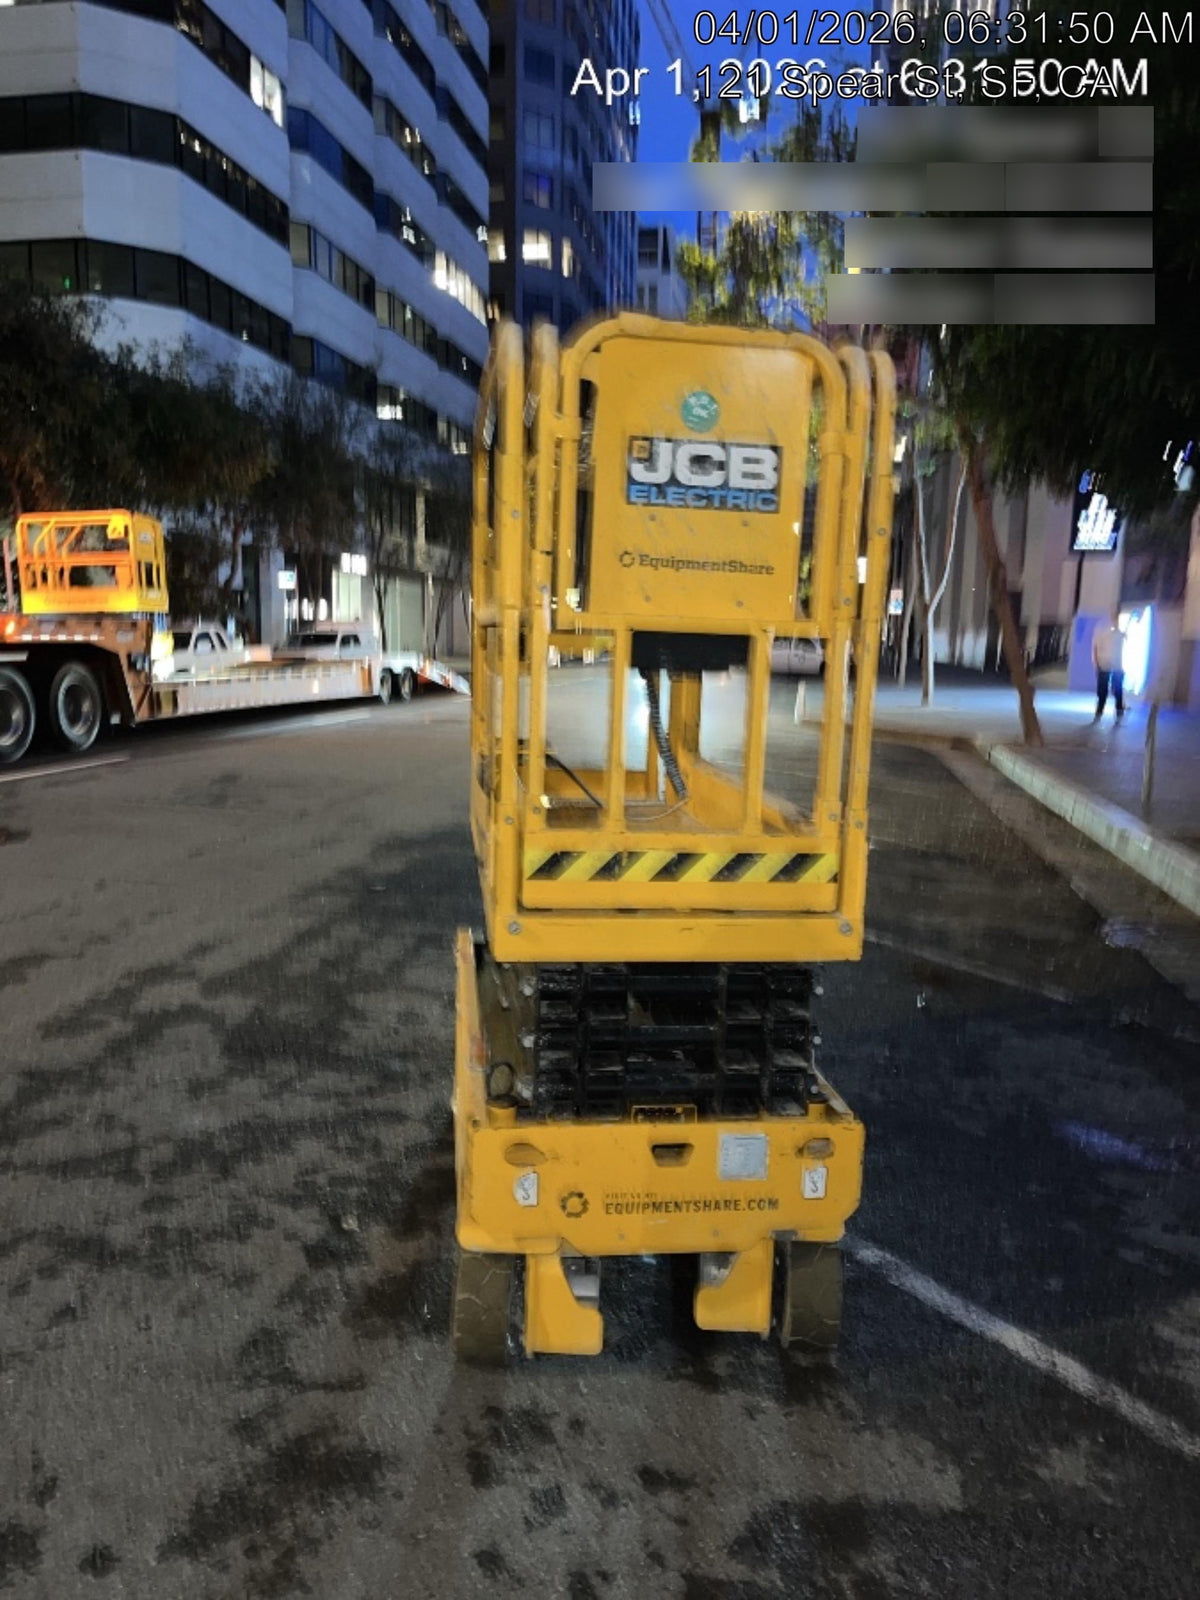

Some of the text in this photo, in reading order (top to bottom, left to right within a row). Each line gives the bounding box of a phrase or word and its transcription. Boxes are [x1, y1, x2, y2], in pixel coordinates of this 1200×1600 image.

[630, 441, 778, 490] JCB
[629, 484, 778, 511] ELECTRIC
[638, 553, 775, 576] EquipmentShare
[605, 1198, 780, 1215] EQUIPMENTSHARE.COM
